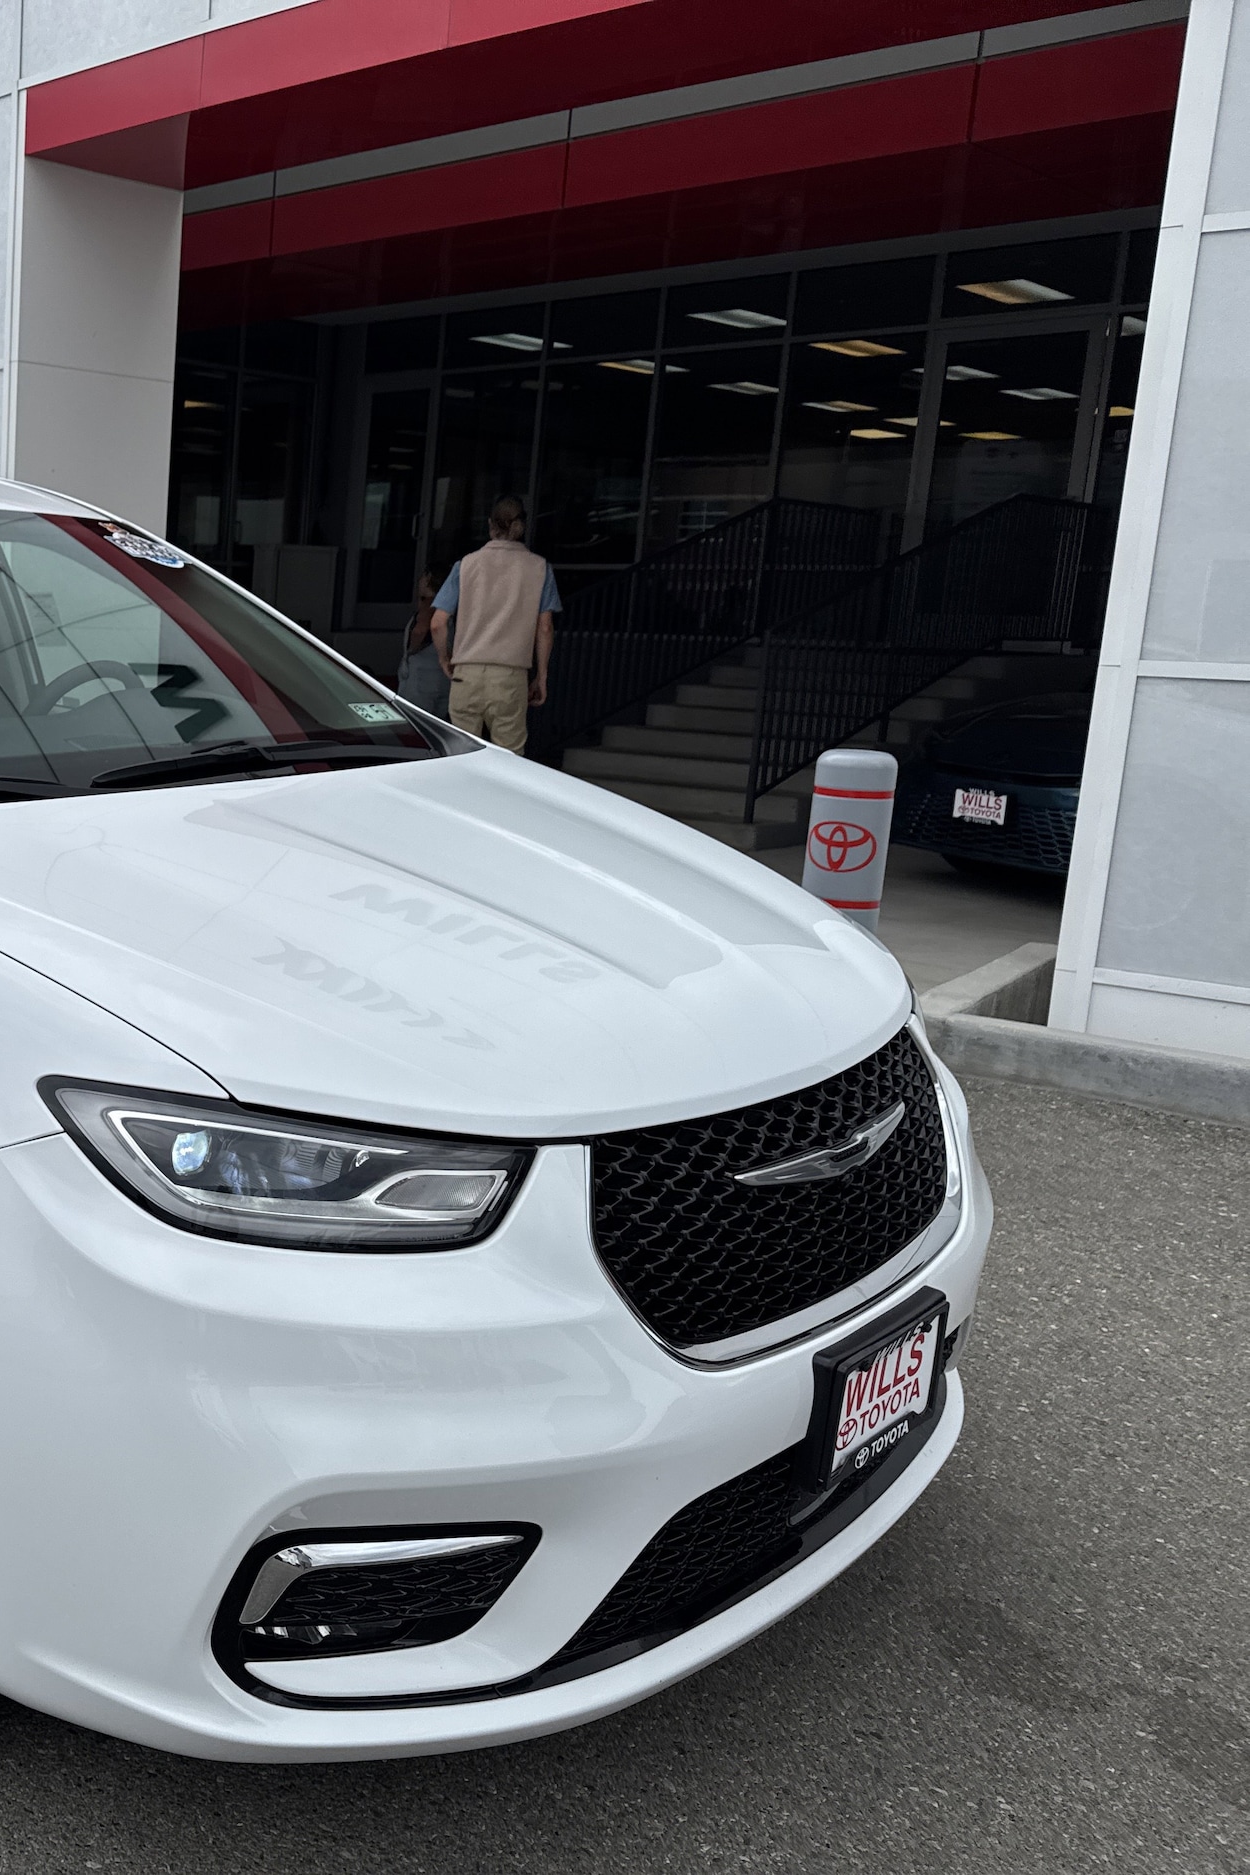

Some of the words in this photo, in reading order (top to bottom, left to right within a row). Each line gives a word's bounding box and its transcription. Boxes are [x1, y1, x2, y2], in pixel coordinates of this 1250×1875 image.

[962, 793, 1002, 811] WILLS
[970, 808, 1001, 819] TOYOTA
[845, 1333, 925, 1418] WILLS
[860, 1378, 920, 1435] TOYOTA
[871, 1420, 910, 1457] TOYOTA
